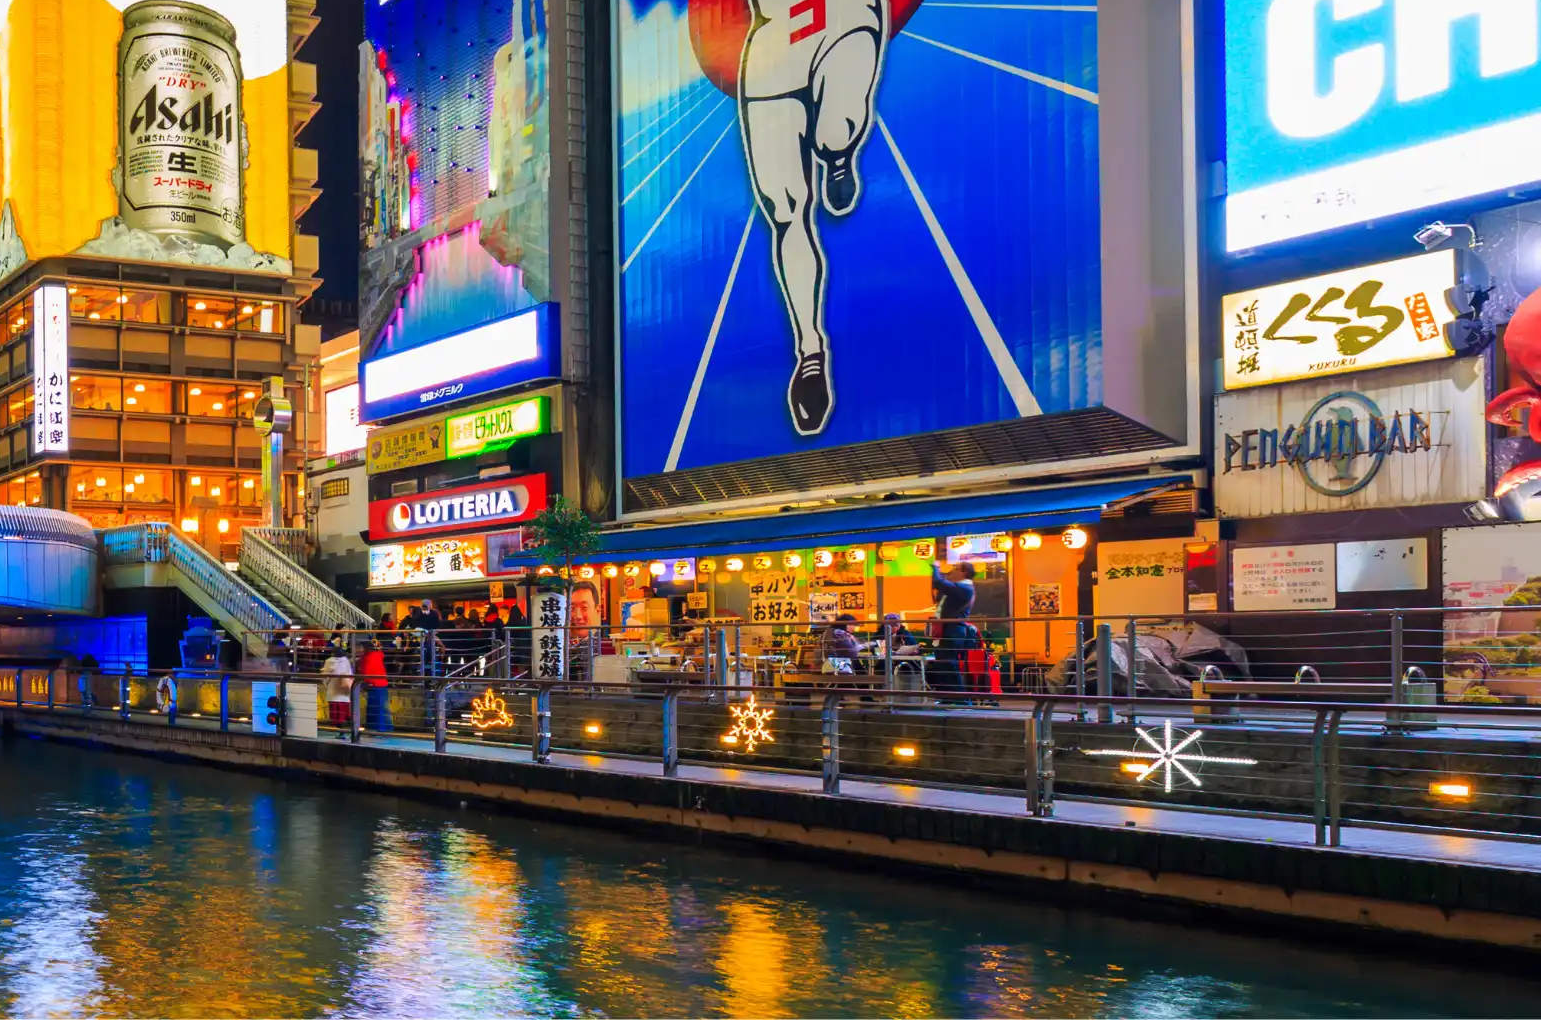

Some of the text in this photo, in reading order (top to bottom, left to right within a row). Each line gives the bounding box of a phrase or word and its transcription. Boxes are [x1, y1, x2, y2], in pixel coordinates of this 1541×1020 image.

[159, 47, 199, 61] BREWERIES
[199, 57, 222, 83] LIMITED
[129, 83, 233, 145] Asahi
[167, 151, 198, 175] 生
[153, 176, 213, 192] スーパードライ
[170, 211, 197, 224] 350ml
[1262, 279, 1406, 357] くくる
[1234, 298, 1261, 377] 道頓堀
[1307, 356, 1358, 373] KUKURU
[419, 383, 464, 403] 雪印メグミルク
[49, 371, 64, 444] かに道楽
[475, 410, 514, 440] ピタットハウス
[1222, 407, 1432, 475] PENGUIN BAR
[414, 489, 513, 524] LOTTERIA
[424, 552, 463, 574] 壱番
[750, 574, 797, 596] 串カツ
[753, 600, 799, 622] お好み
